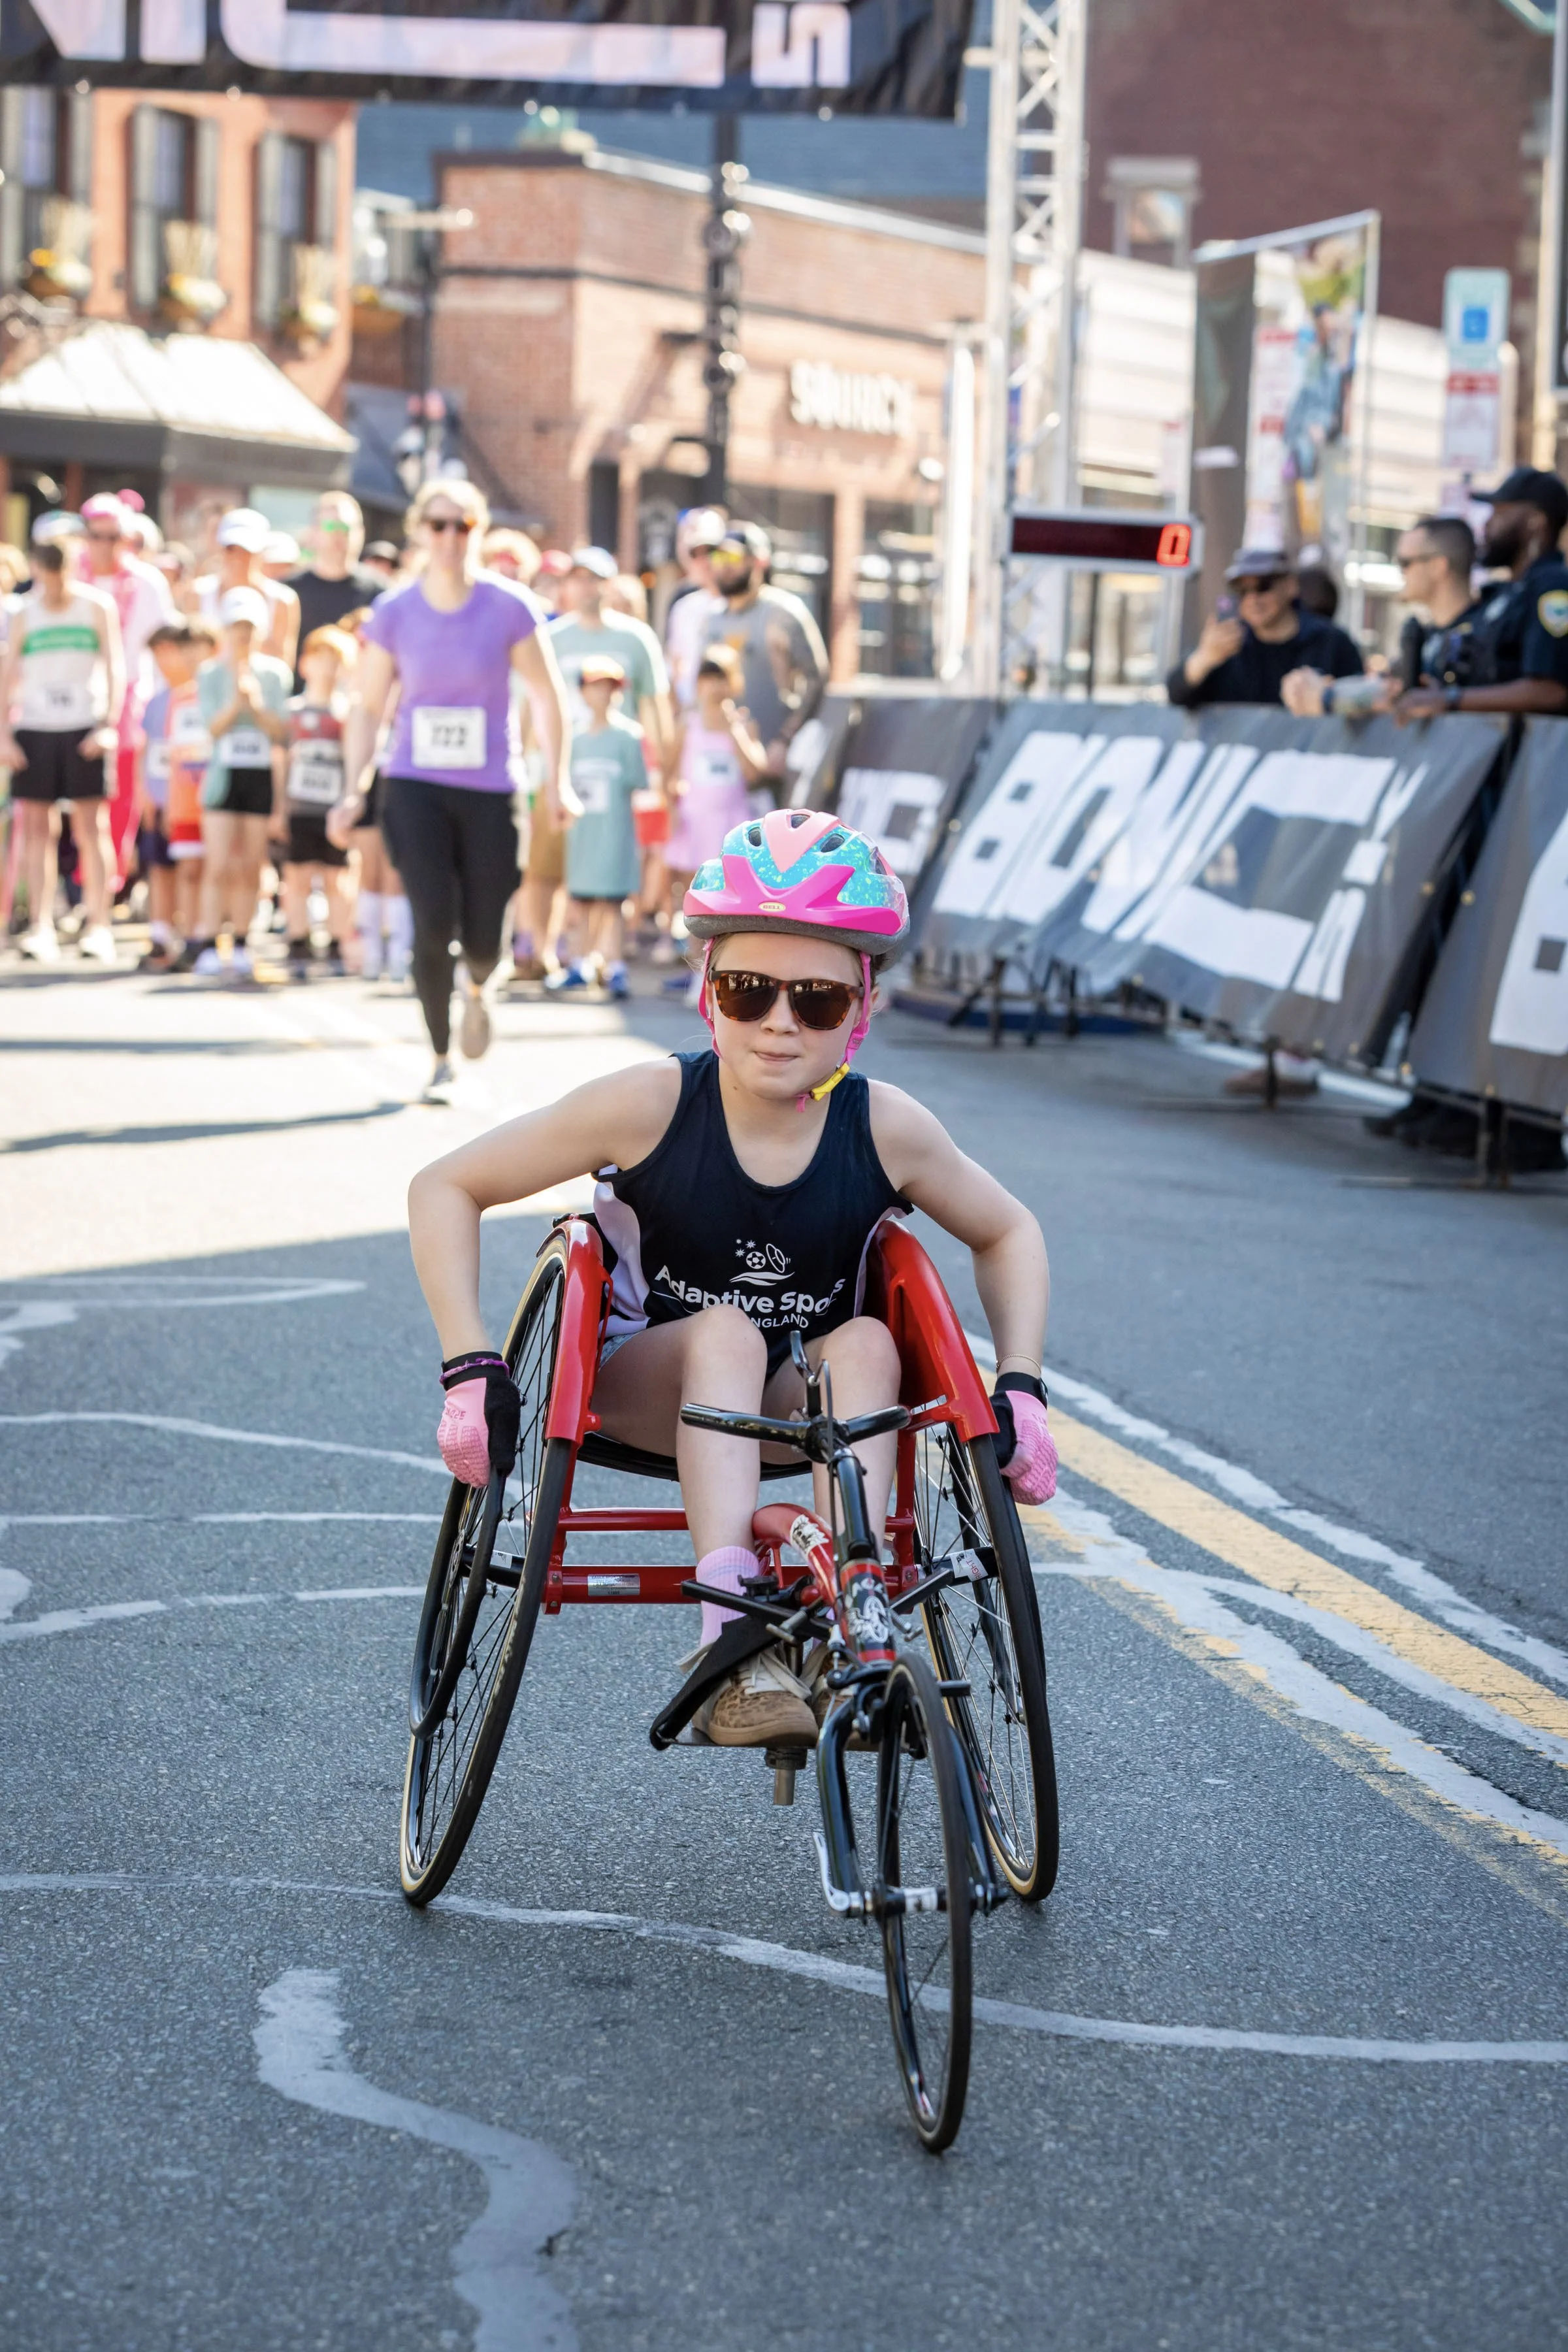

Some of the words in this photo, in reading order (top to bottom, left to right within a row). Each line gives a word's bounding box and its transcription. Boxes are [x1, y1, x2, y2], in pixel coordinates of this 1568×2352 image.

[1156, 523, 1192, 567] 0
[655, 1265, 774, 1313] Adaptive
[779, 1279, 845, 1314] Spos
[751, 1313, 809, 1328] NGLAND
